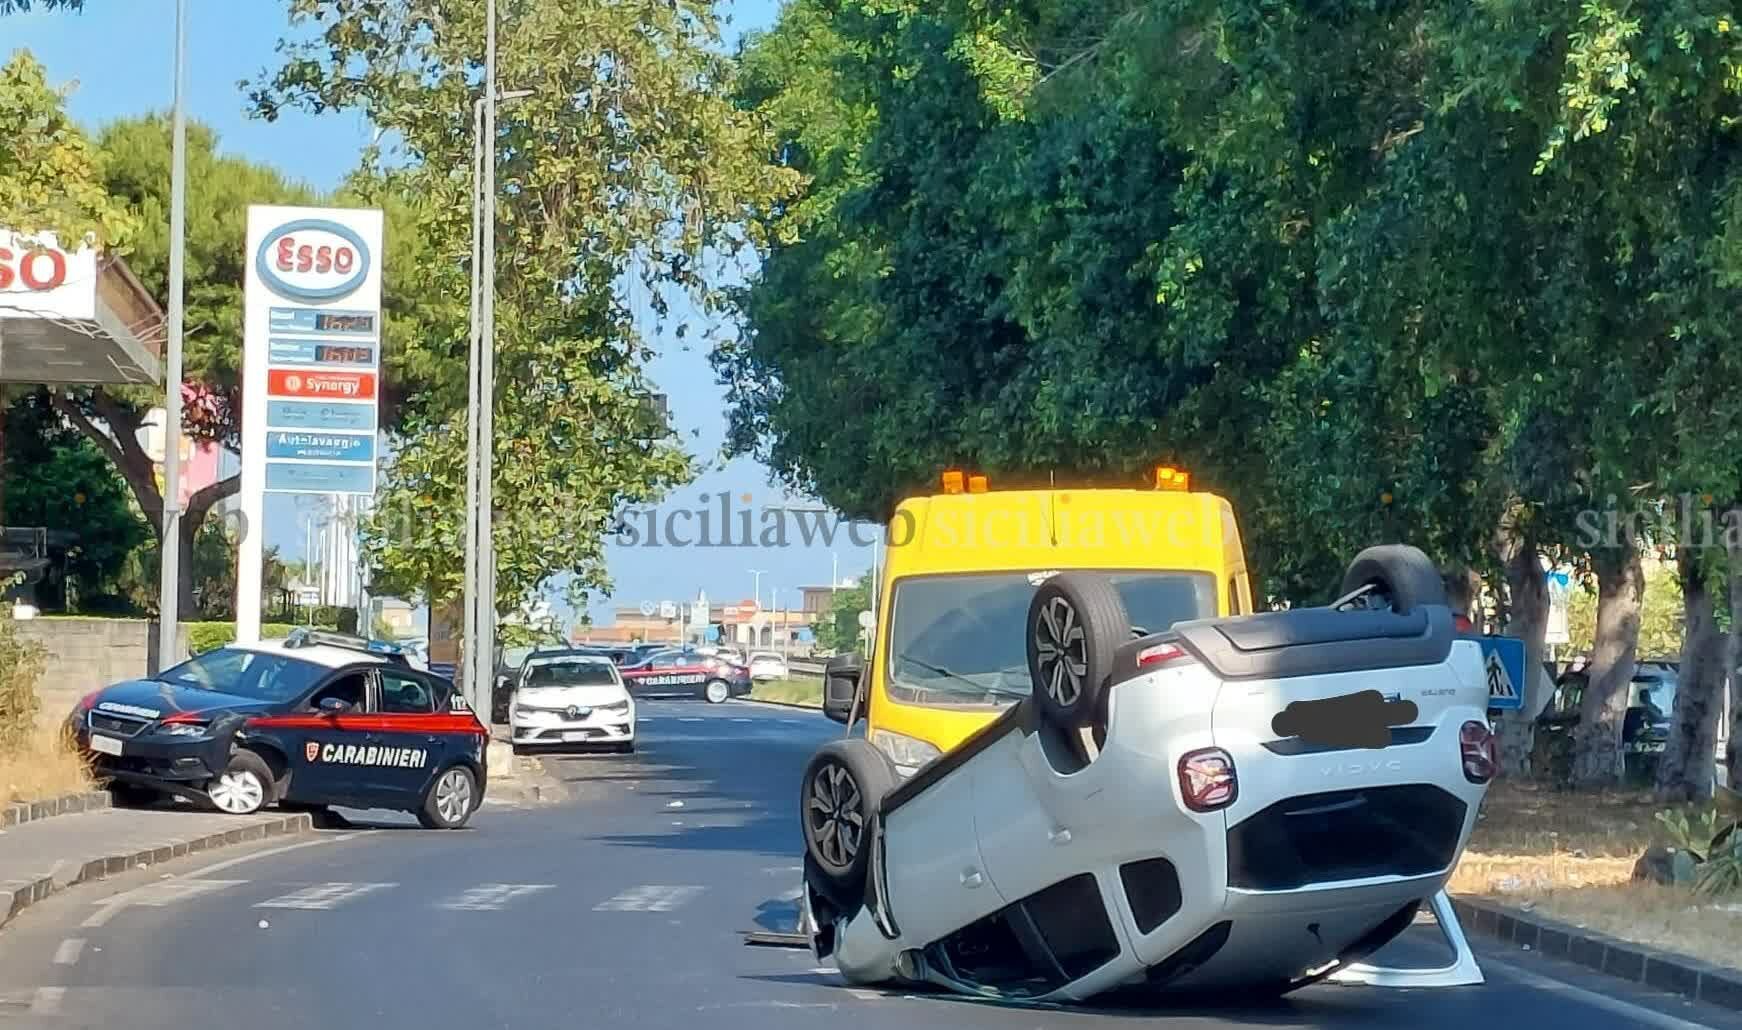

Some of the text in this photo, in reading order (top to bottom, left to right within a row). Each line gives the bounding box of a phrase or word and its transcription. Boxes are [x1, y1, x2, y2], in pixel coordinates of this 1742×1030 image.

[276, 237, 353, 274] Esso
[306, 377, 360, 396] Synergy
[322, 743, 427, 768] CARABINIERI
